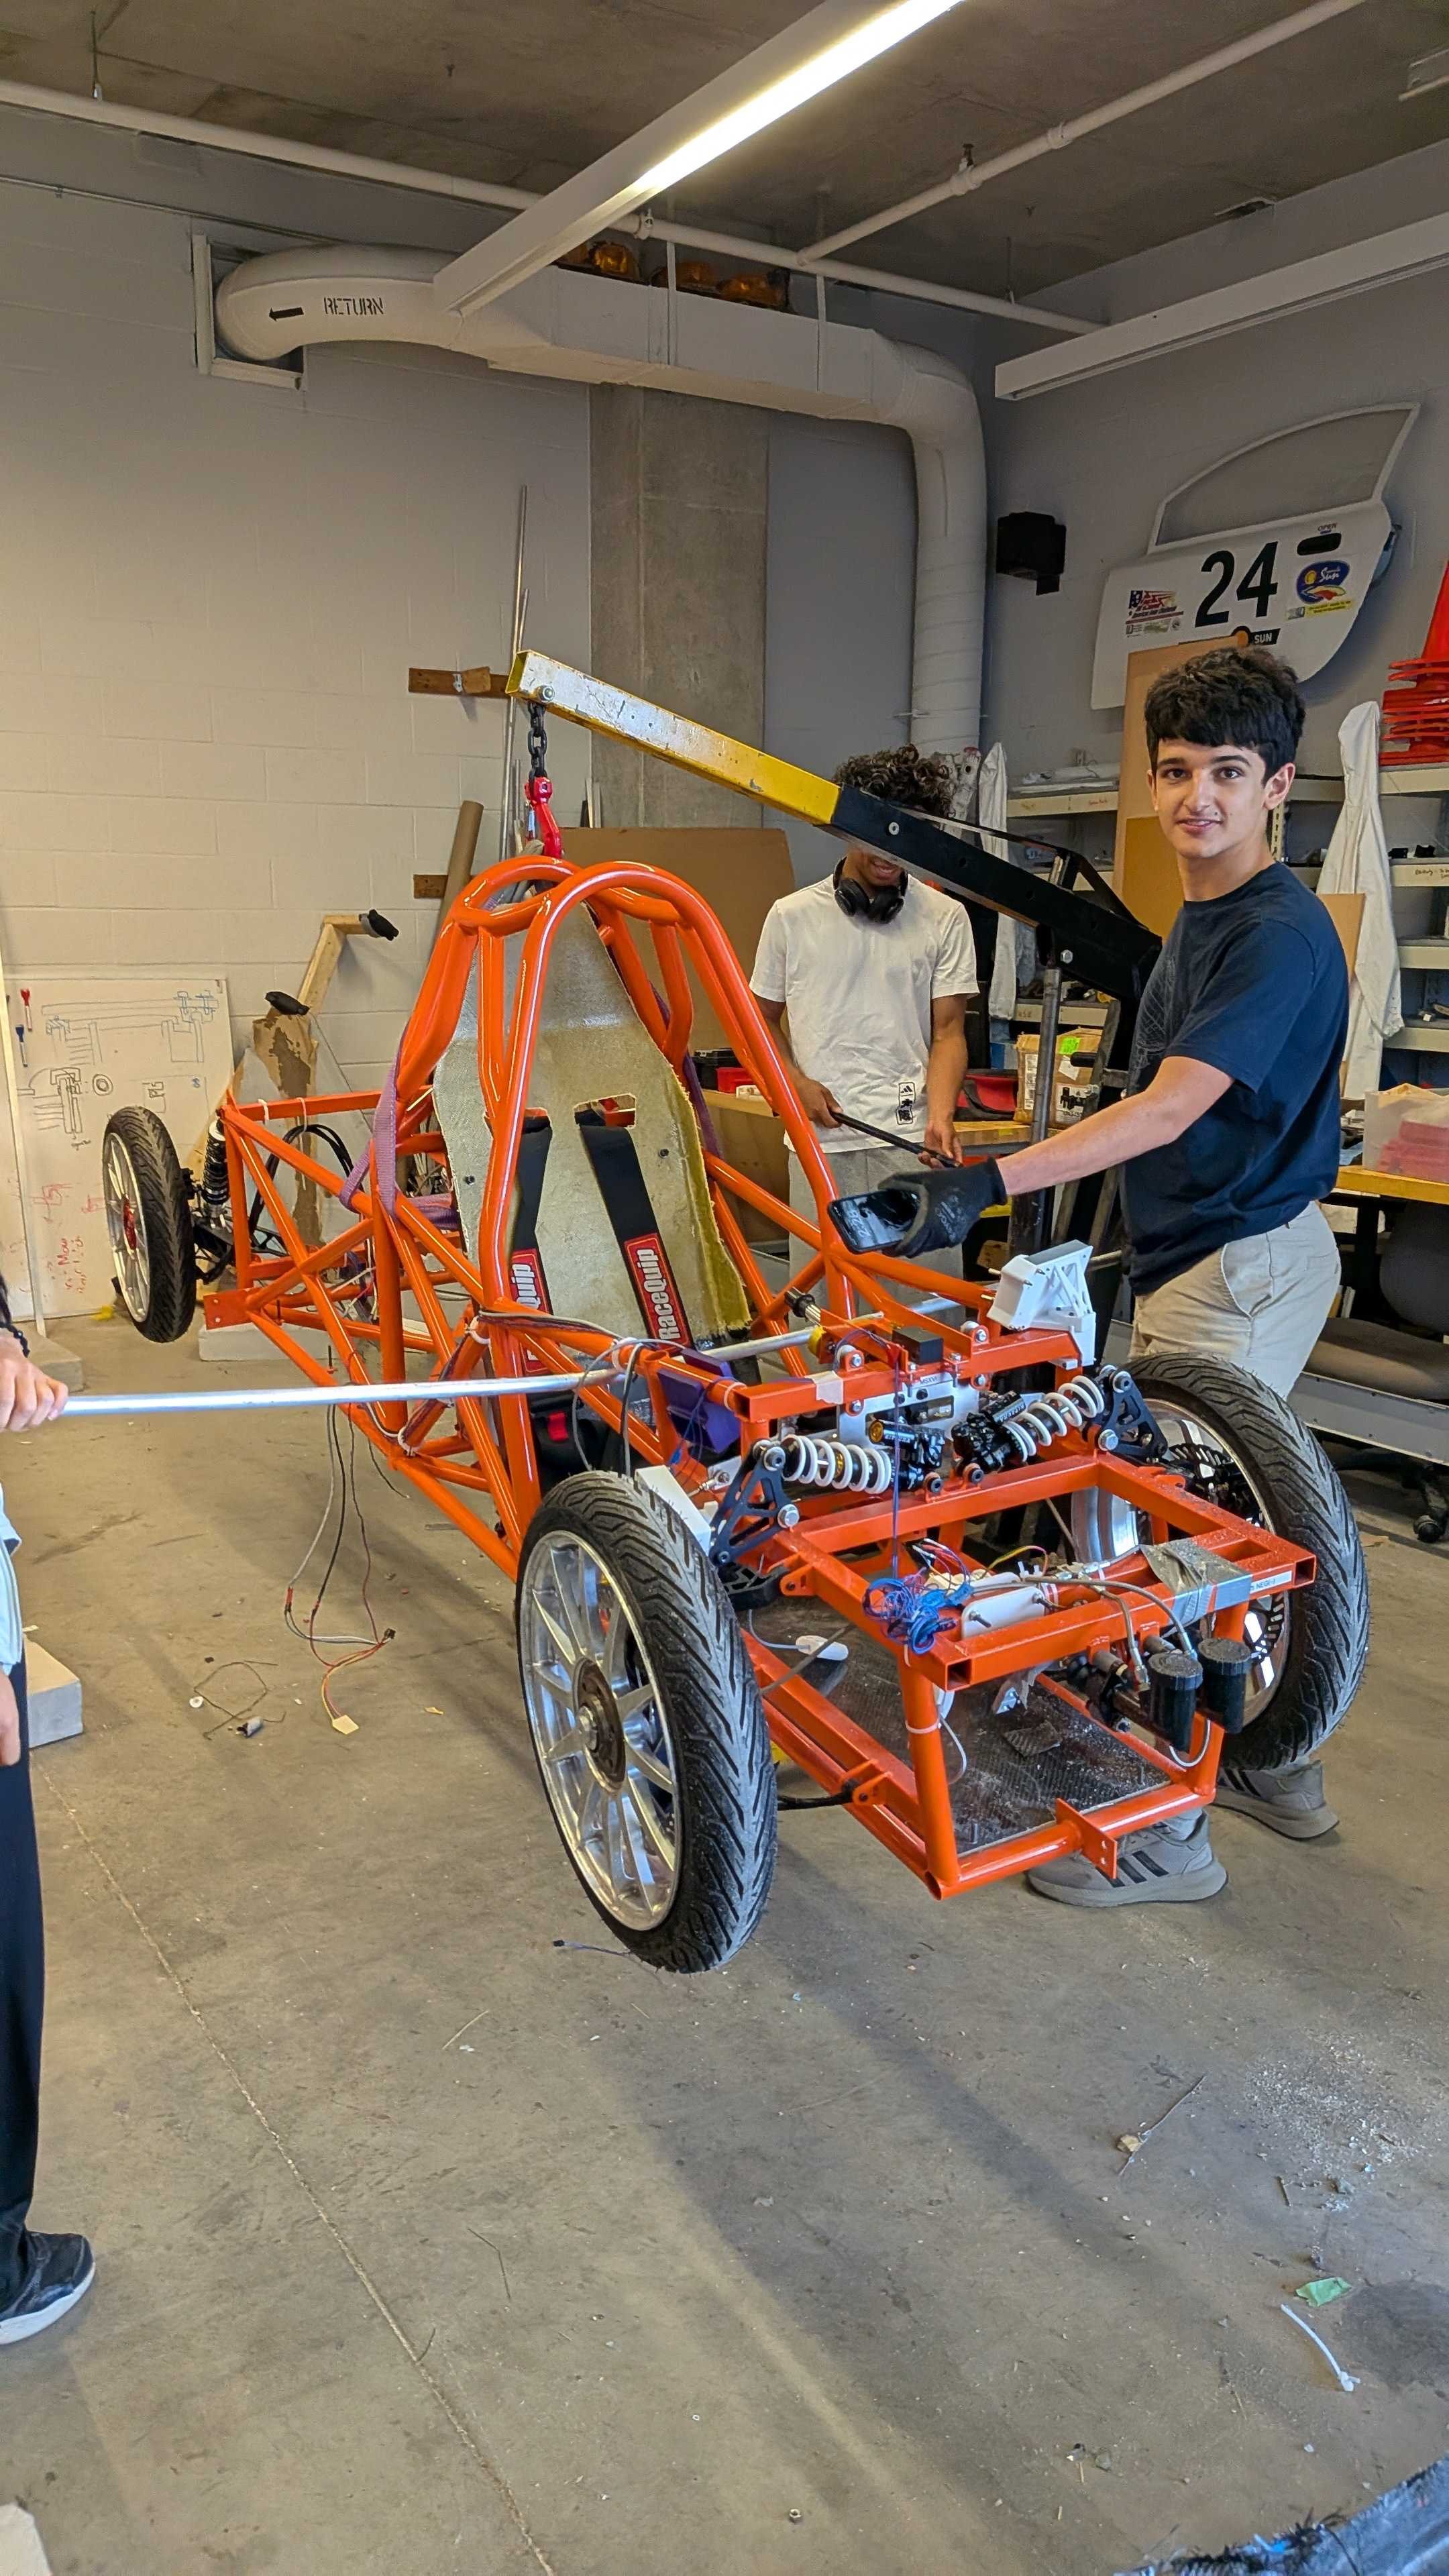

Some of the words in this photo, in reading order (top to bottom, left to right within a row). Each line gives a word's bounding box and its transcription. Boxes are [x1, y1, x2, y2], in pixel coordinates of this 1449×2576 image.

[323, 297, 384, 315] RETURN
[1318, 523, 1338, 532] OPEN
[1195, 541, 1279, 627] 24
[1254, 632, 1273, 644] SUN
[511, 1263, 541, 1309] Quip
[637, 1248, 681, 1340] RaceQuip
